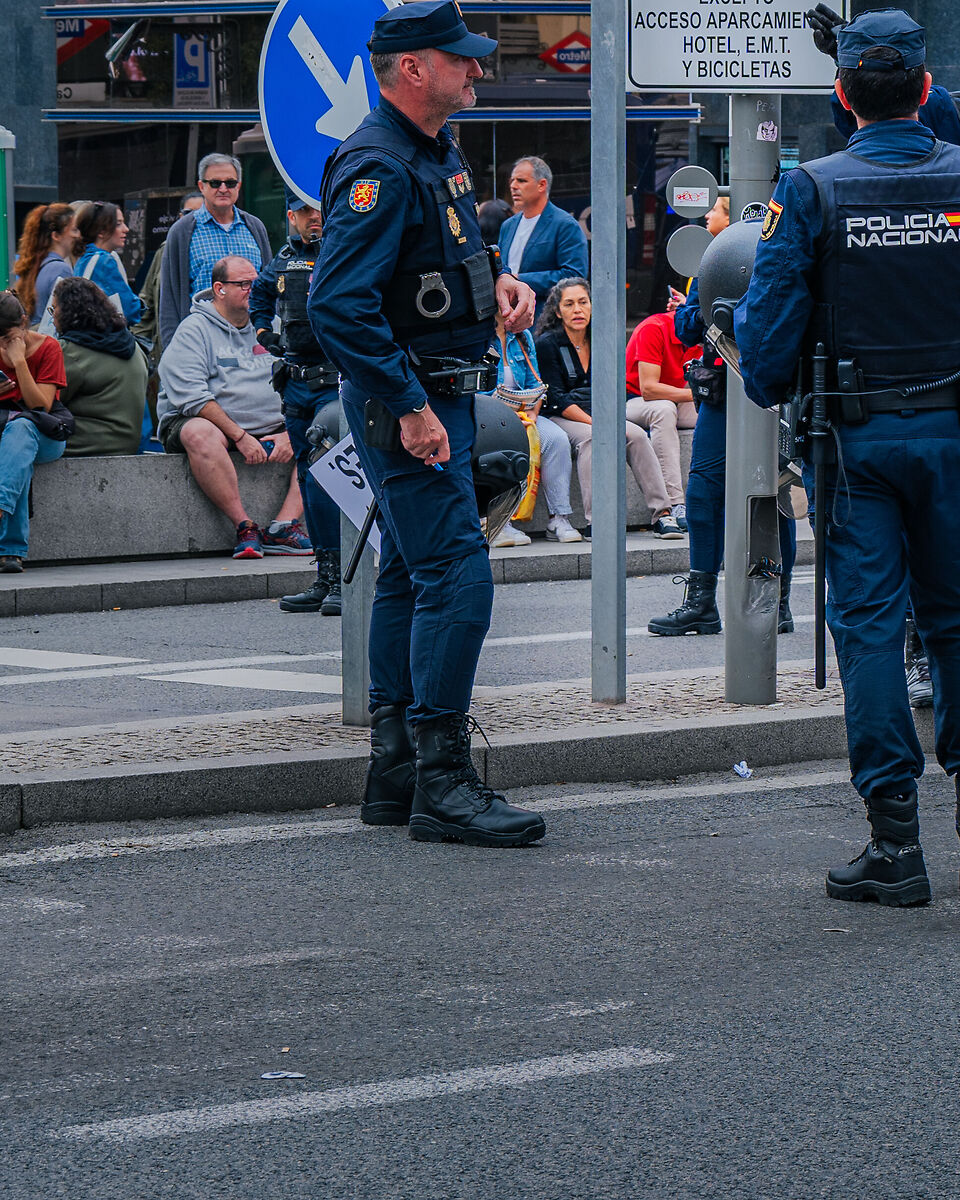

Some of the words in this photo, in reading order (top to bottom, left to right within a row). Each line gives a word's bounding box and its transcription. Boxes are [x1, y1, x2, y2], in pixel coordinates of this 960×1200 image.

[634, 12, 701, 29] ACCESO
[683, 36, 741, 56] HOTEL,
[746, 36, 791, 53] E.M.T.
[682, 61, 692, 78] Y
[698, 60, 792, 78] BICICLETAS
[846, 212, 950, 232] POLICIA
